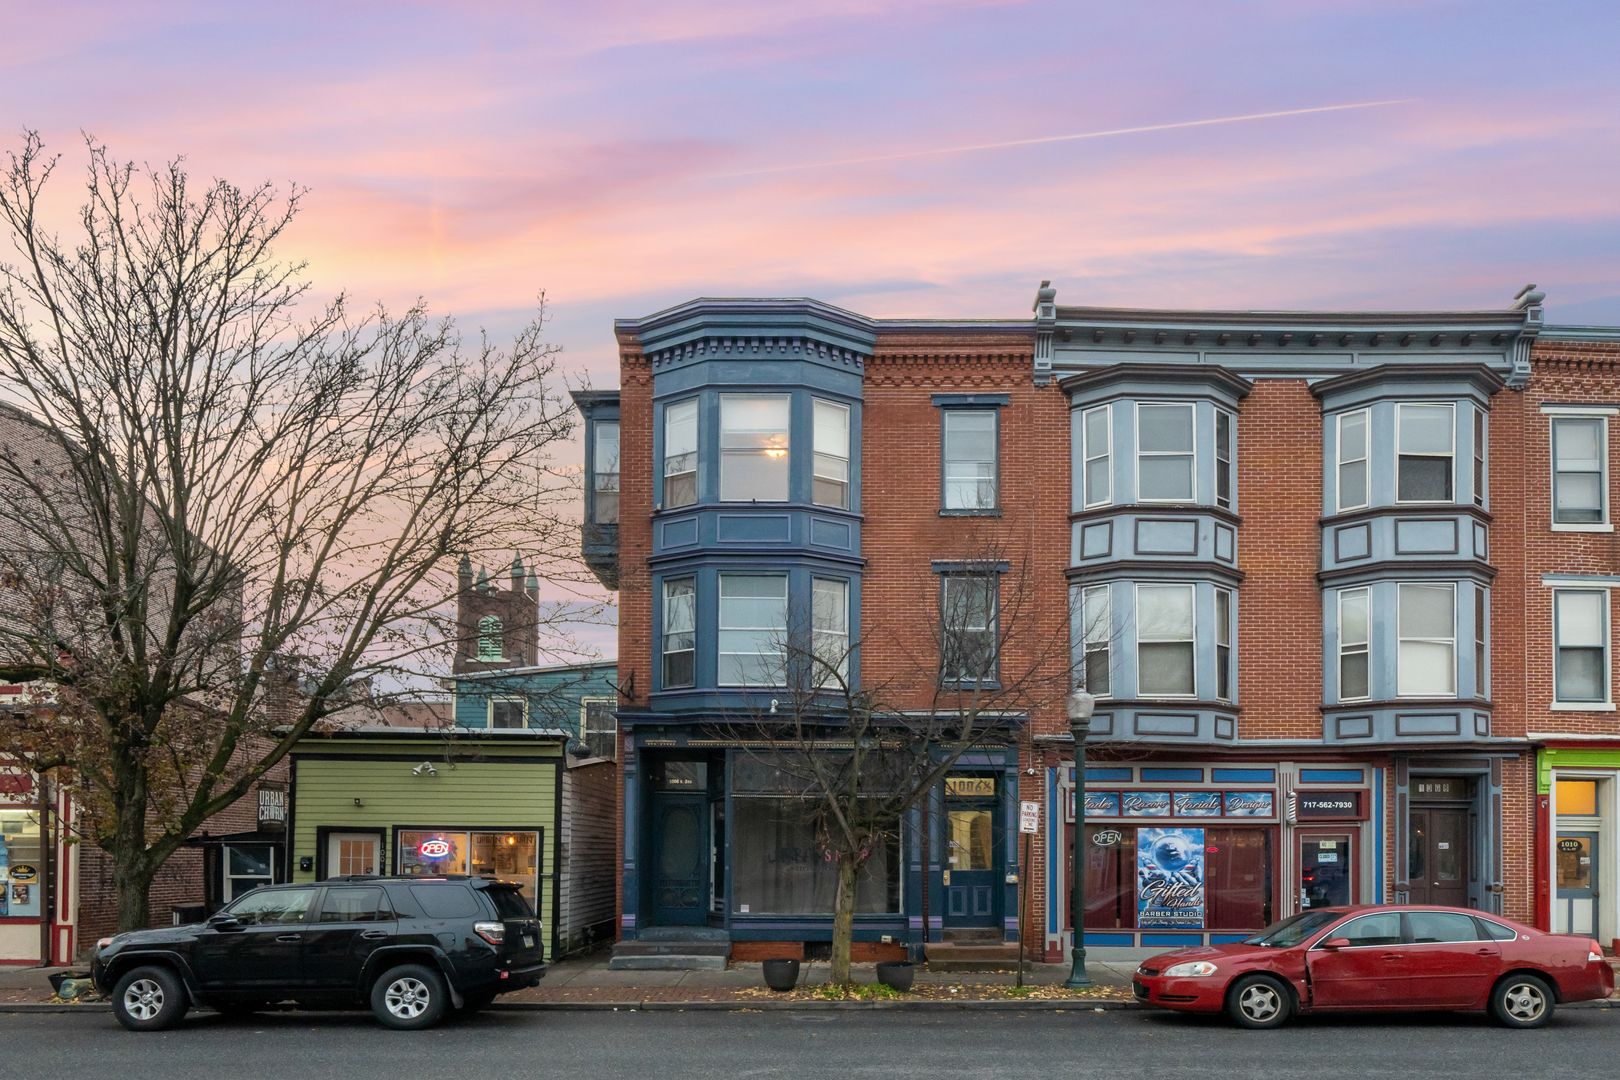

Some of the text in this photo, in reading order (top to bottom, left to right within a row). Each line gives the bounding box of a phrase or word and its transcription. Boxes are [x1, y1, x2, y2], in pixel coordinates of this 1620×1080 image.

[259, 790, 284, 806] URBAN
[1122, 796, 1168, 811] Razors
[1174, 796, 1218, 813] Facials
[1226, 796, 1270, 814] Designs
[1093, 833, 1122, 843] OPEN
[420, 843, 448, 854] OPEN
[1140, 880, 1202, 904] Gifted
[1166, 897, 1201, 908] Hands
